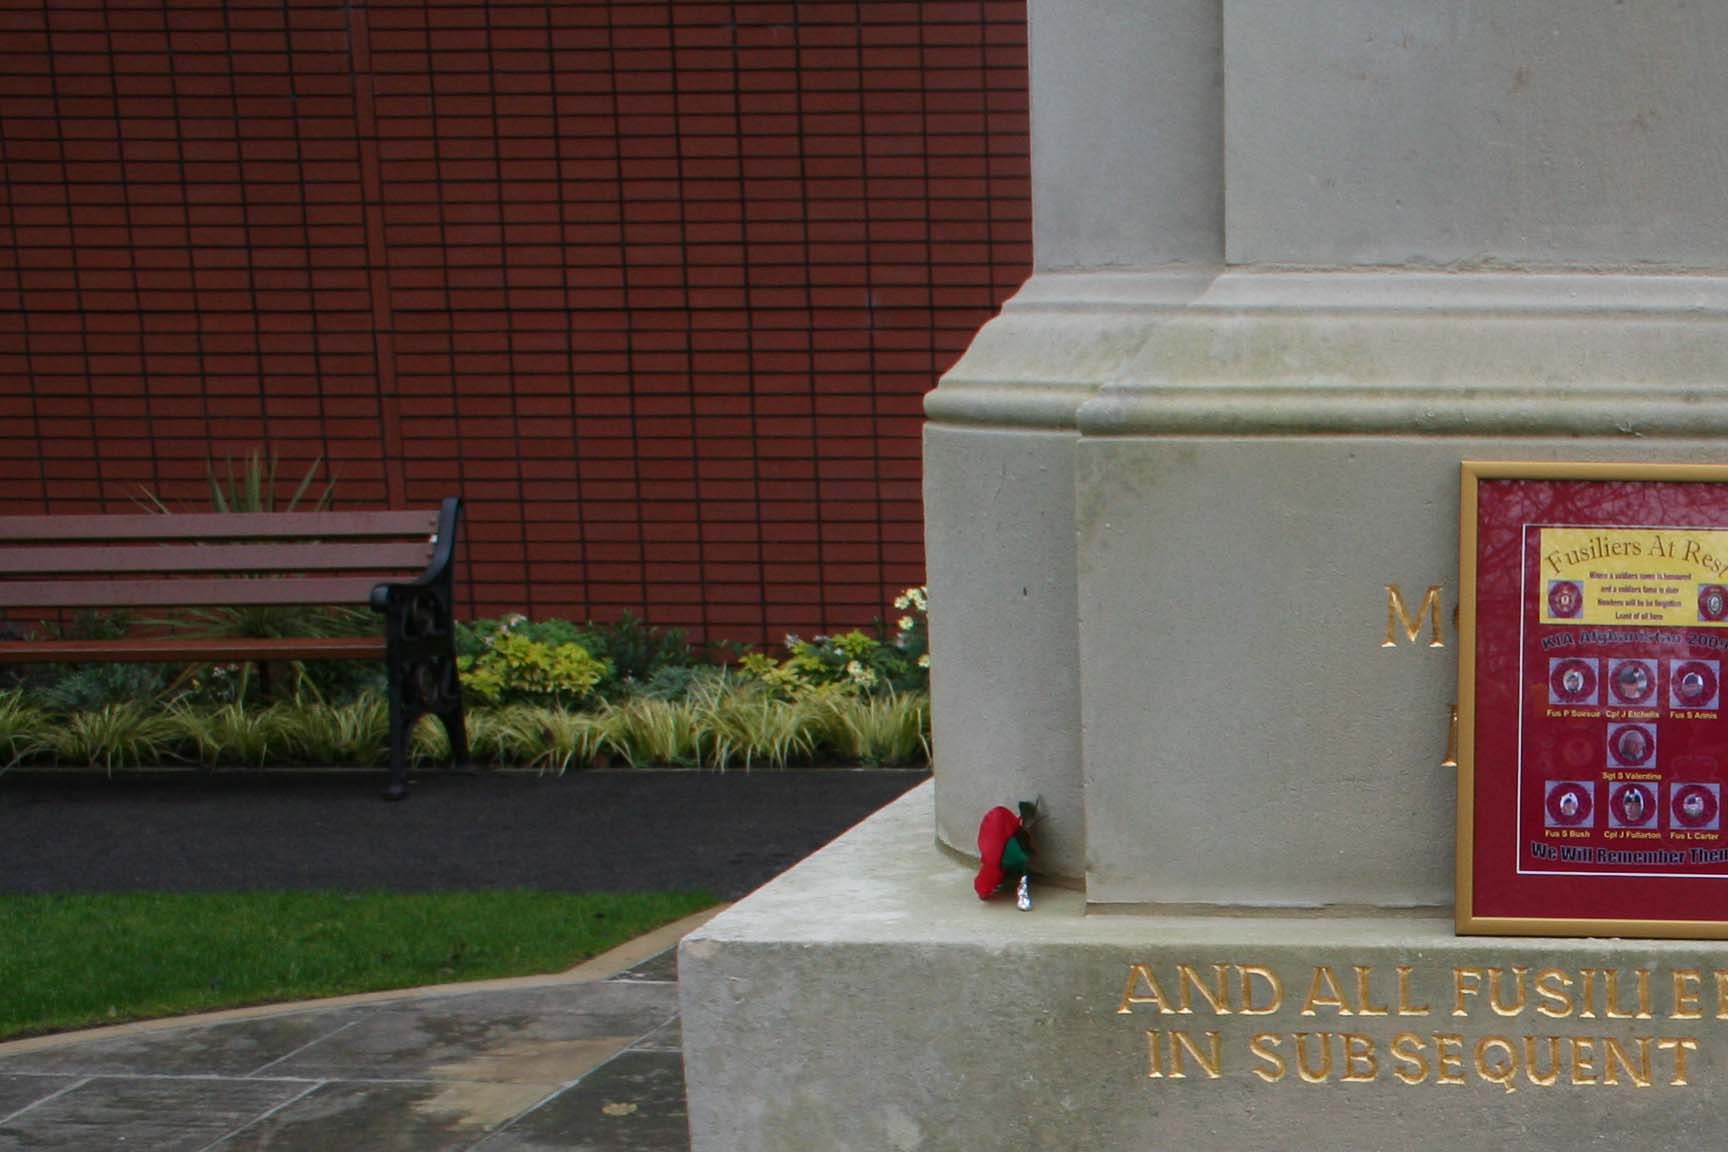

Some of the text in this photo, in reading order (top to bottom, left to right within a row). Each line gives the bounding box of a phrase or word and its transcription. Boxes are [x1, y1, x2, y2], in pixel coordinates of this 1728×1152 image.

[1545, 536, 1642, 575] Fusiliers
[1648, 535, 1676, 557] At
[1542, 631, 1574, 651] KIA
[1579, 630, 1682, 646] Afghanistan
[1546, 708, 1562, 718] Fus
[1669, 710, 1685, 719] Fus
[1602, 771, 1617, 782] Sgt
[1625, 772, 1662, 781] Valentine
[1545, 829, 1561, 838] Fus
[1569, 829, 1591, 838] Bush
[1603, 830, 1618, 840] Cpl
[1670, 831, 1686, 840] Fus
[1694, 832, 1719, 840] Carter
[1531, 841, 1558, 860] We
[1560, 844, 1593, 863] Will
[1597, 847, 1687, 865] Remember
[1117, 964, 1285, 1015] AND
[1301, 965, 1432, 1017] ALL
[1146, 1029, 1224, 1079] IN
[1248, 1031, 1698, 1094] SUBSEQUENT
